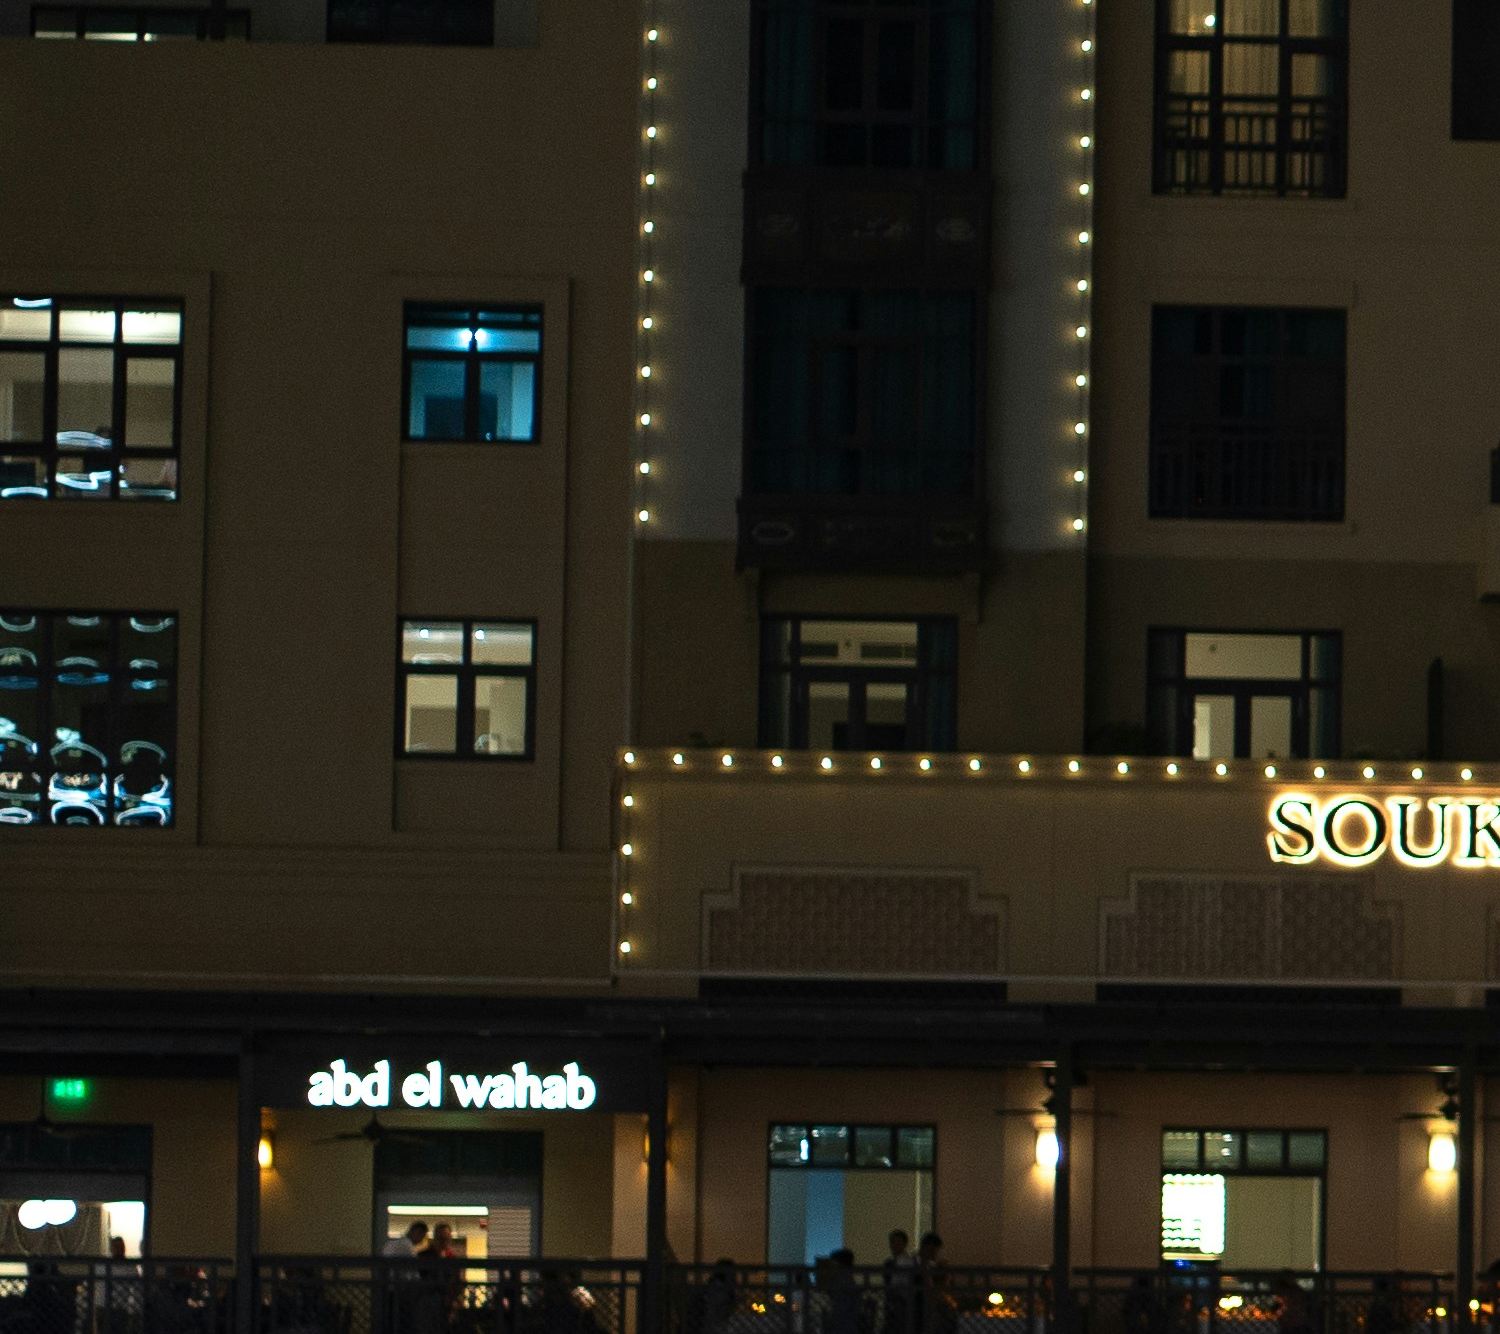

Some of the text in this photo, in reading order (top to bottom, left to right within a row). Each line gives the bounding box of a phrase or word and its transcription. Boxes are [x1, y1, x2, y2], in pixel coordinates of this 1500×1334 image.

[307, 1059, 596, 1110] abd el wahab
